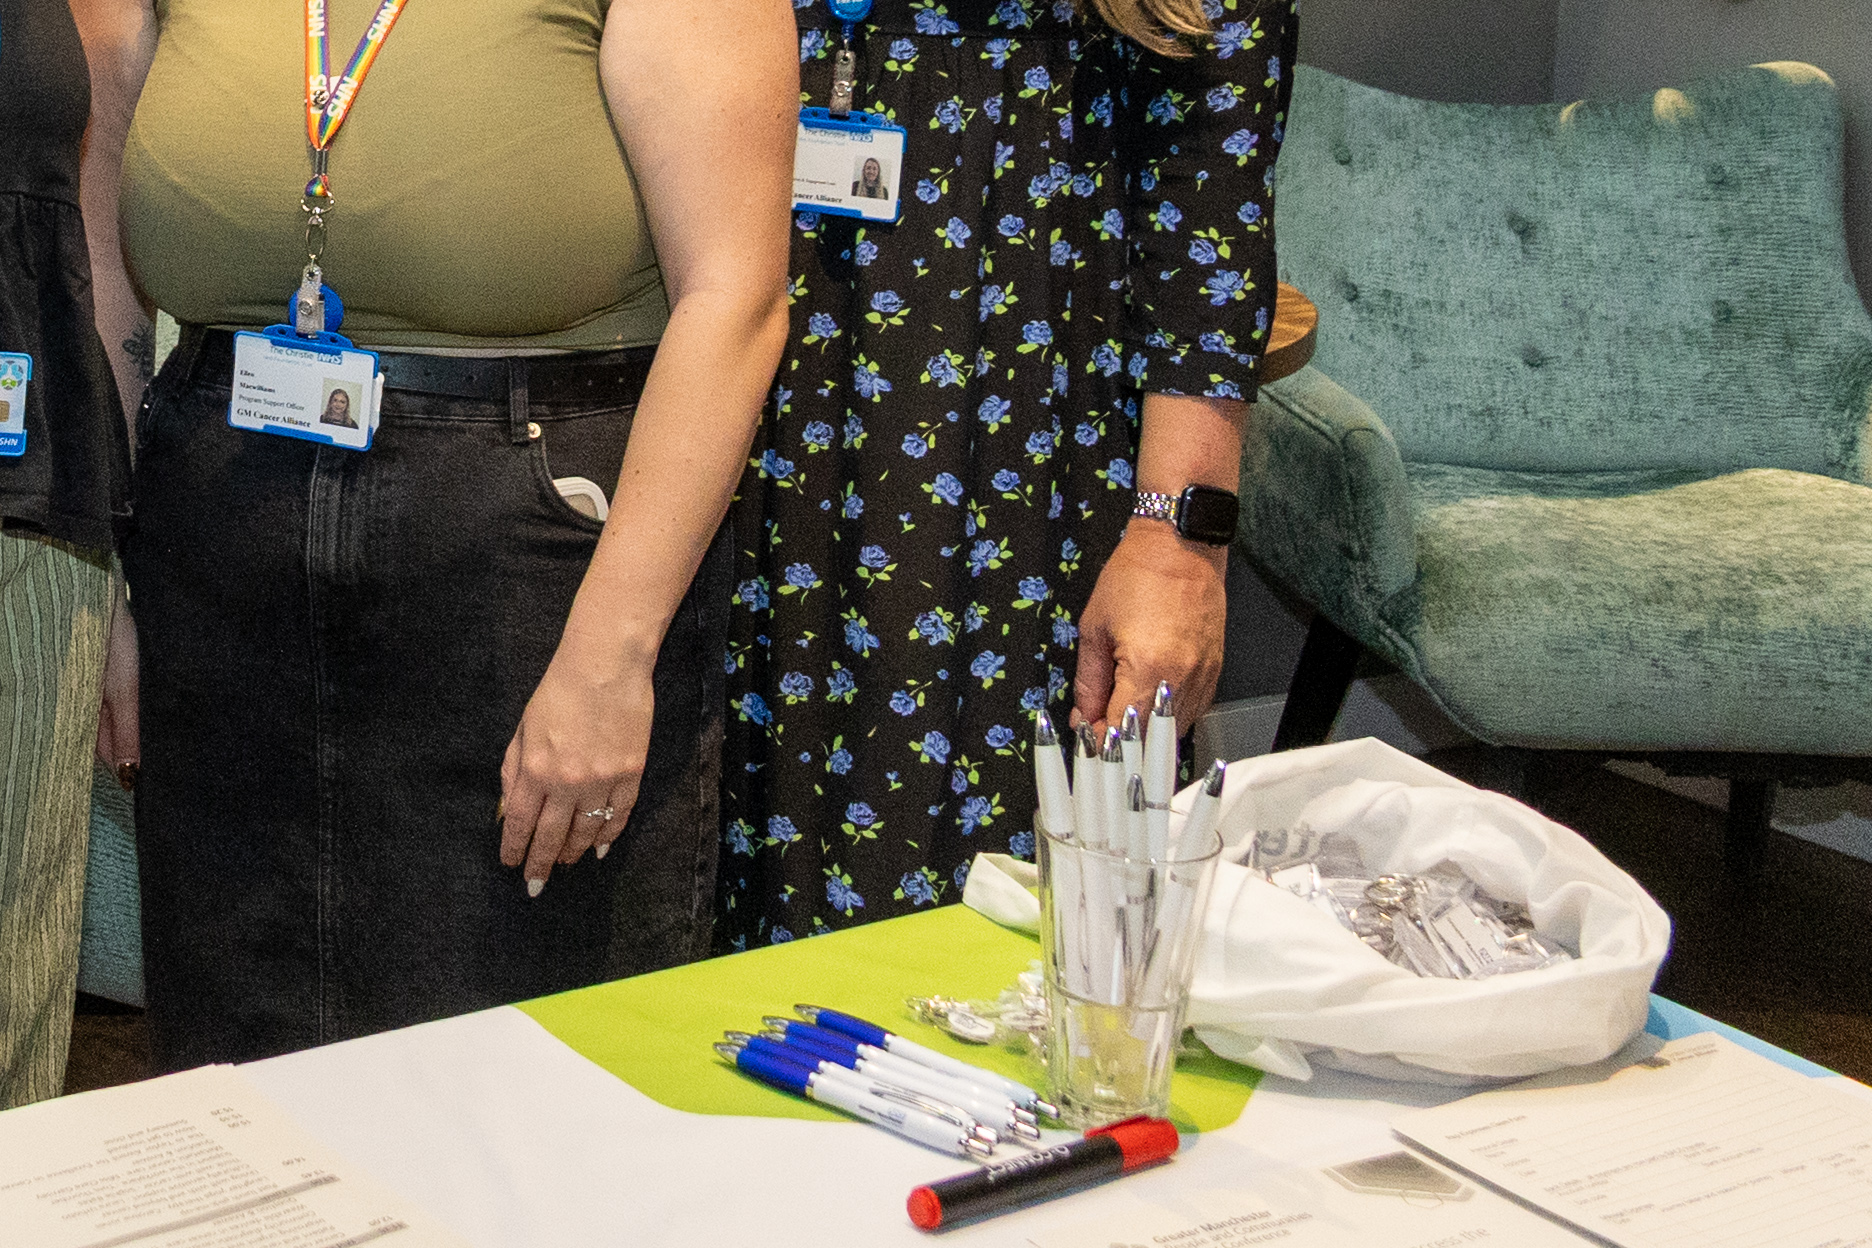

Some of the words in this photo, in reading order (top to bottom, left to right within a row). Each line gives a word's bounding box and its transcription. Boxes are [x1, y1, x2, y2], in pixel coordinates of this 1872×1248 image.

[366, 1, 398, 43] NHS
[327, 76, 358, 119] NHS
[815, 194, 843, 203] Alliance
[285, 347, 314, 359] Christie
[318, 353, 342, 364] NHS
[263, 398, 285, 408] Support
[286, 402, 305, 411] Officer
[237, 408, 251, 417] GM
[253, 410, 280, 422] Cancer
[281, 416, 311, 428] Alliance
[0, 438, 18, 446] NHS
[1152, 1227, 1200, 1244] Greater
[1199, 1210, 1272, 1232] Manchester
[1211, 1230, 1234, 1242] and
[1233, 1212, 1313, 1235] Communities
